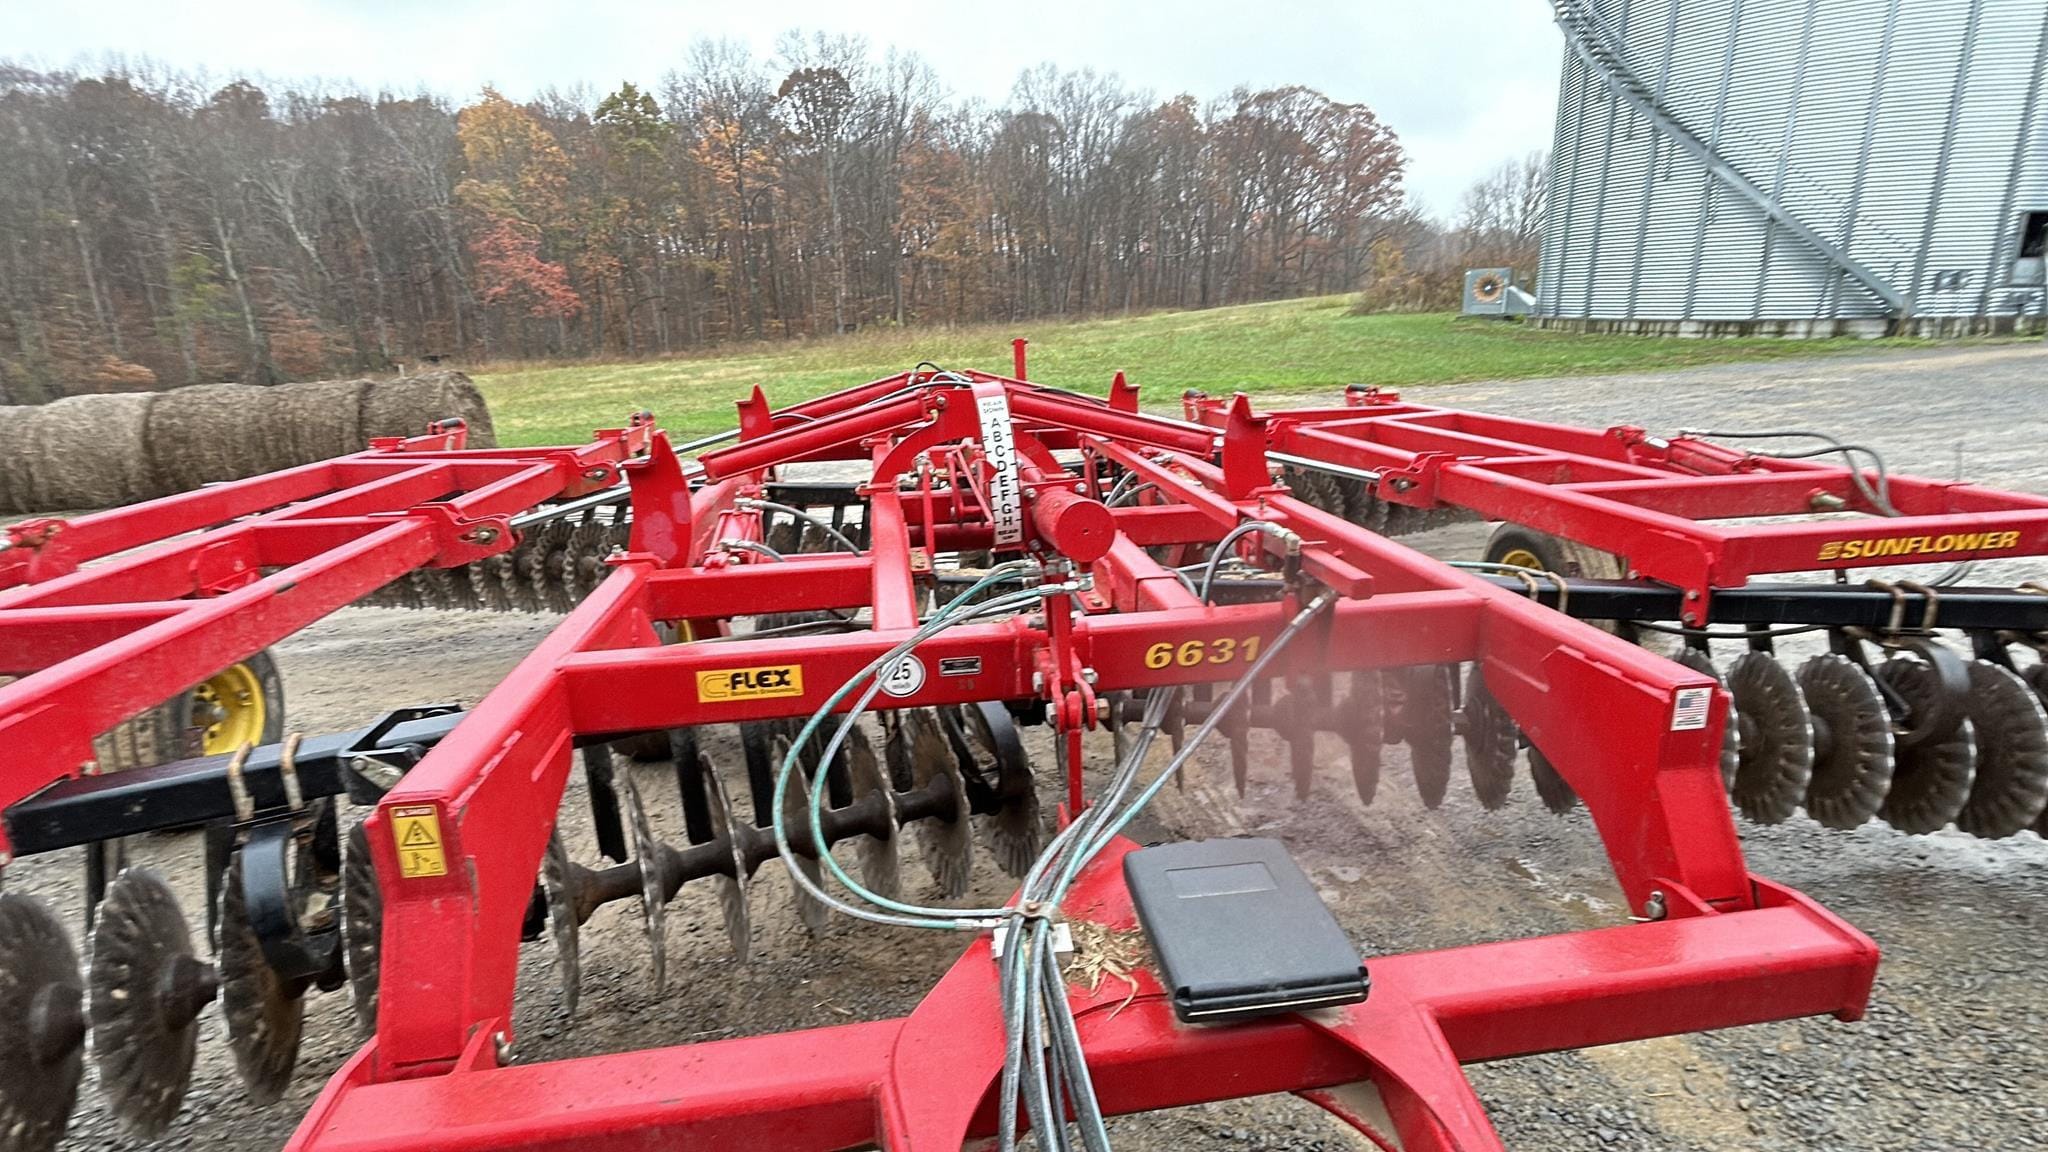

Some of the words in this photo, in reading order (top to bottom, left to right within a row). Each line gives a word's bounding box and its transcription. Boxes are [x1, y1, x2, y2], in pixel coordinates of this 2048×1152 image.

[991, 418, 1001, 429] A
[993, 431, 1003, 442] B
[995, 445, 1006, 457] C
[997, 460, 1007, 472] D
[1000, 475, 1009, 488] E
[1000, 490, 1010, 501] F
[1001, 504, 1012, 514] G
[1002, 516, 1013, 527] H
[1840, 530, 2021, 559] SUNFLOWER
[1144, 636, 1261, 669] 6631
[892, 662, 911, 681] 25
